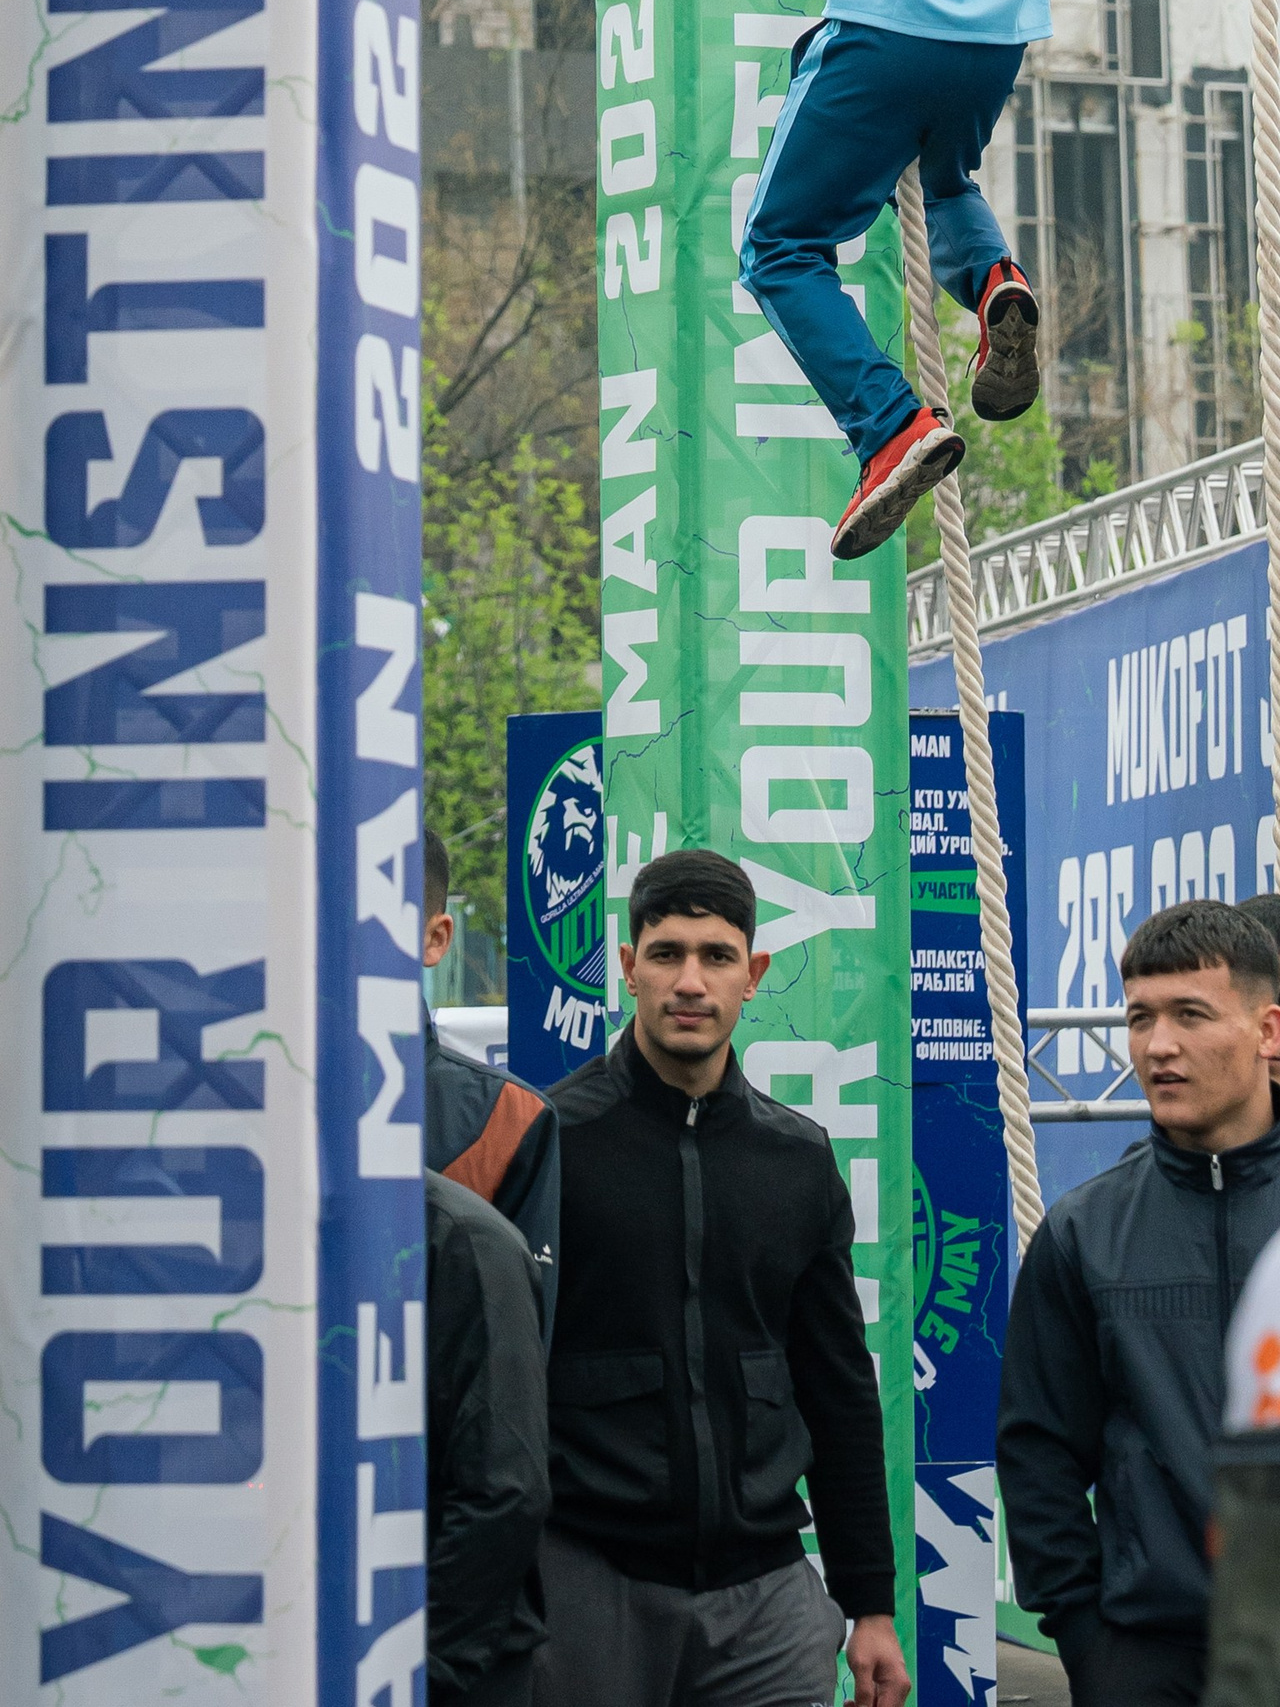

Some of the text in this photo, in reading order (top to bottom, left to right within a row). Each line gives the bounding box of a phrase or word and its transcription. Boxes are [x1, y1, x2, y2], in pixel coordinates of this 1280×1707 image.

[601, 367, 661, 739] MAN
[1106, 613, 1248, 806] MUKOFOT
[738, 515, 875, 957] YOUR
[911, 734, 951, 758] MAN
[915, 789, 971, 810] КТО УЖ
[910, 812, 949, 832] ВАЛ.
[356, 591, 423, 1178] MAN
[918, 880, 981, 900] УЧАСТИ
[911, 969, 976, 993] РАБЛЕЙ
[911, 1018, 987, 1039] УСЛОВИЕ:
[915, 1040, 998, 1062] ФИНИШЕР
[934, 1209, 981, 1314] MAY
[40, 958, 266, 1686] YOUR
